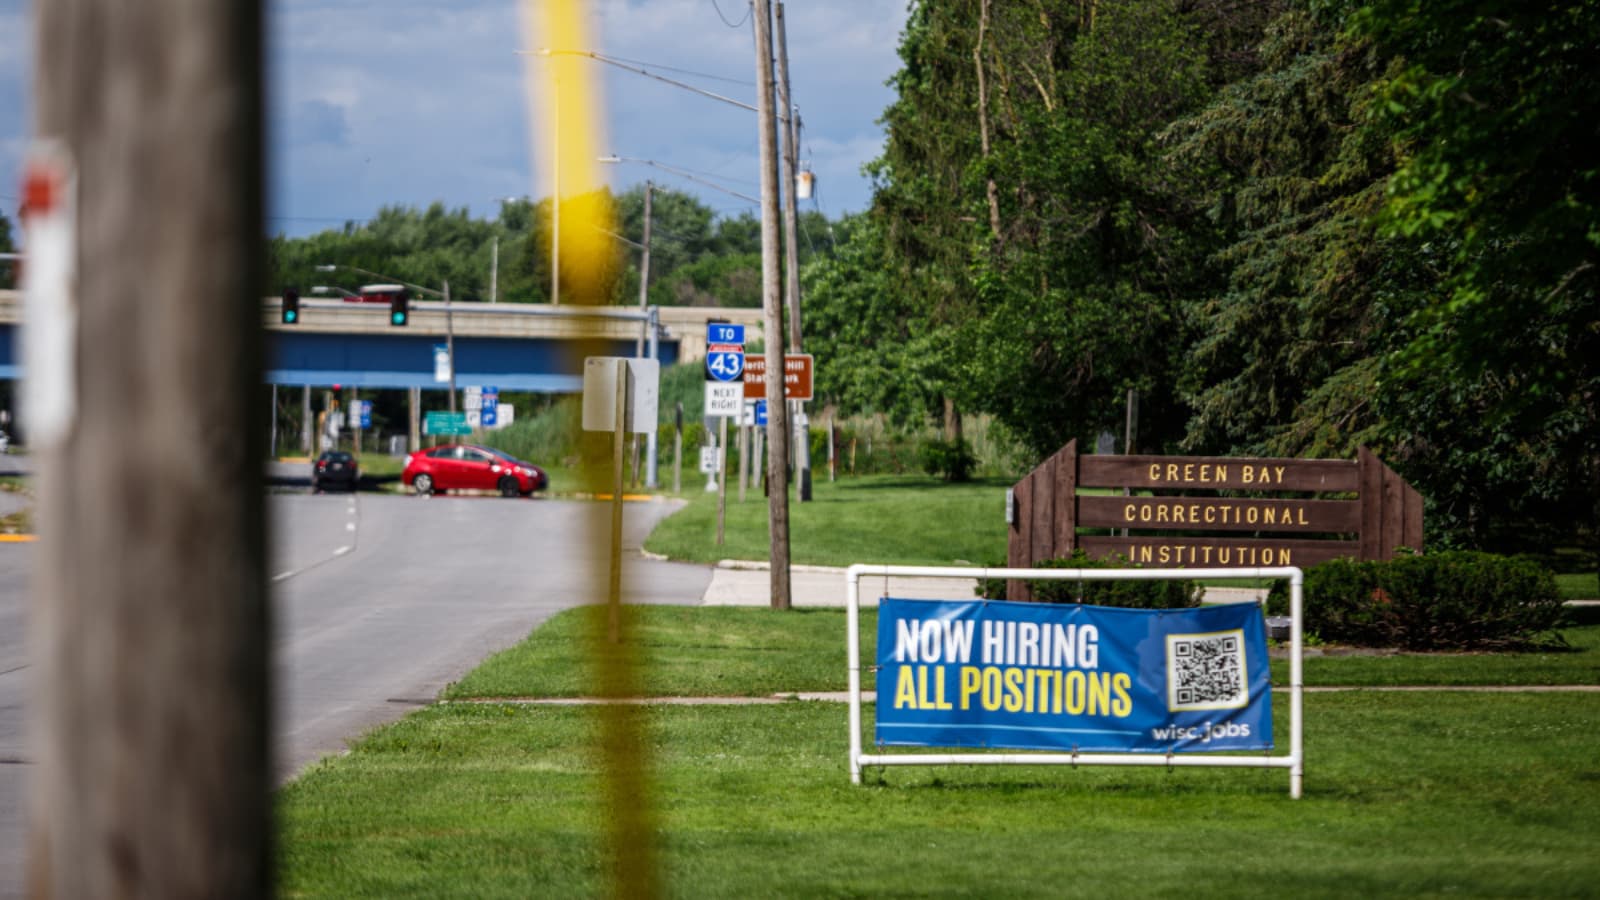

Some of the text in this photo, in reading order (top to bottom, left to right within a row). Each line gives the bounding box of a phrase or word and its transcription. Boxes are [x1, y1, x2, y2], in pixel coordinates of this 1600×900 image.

[719, 328, 735, 340] TO
[711, 354, 740, 375] 43
[786, 360, 804, 370] Hill
[745, 373, 799, 384] Stat ark
[713, 388, 735, 397] NEXT
[711, 400, 736, 409] RIGHT
[1149, 464, 1286, 484] GREEN BAY
[1124, 503, 1309, 526] CORRECTIONAL
[1129, 545, 1292, 566] INSTITUTION
[896, 618, 1099, 669] NOW HIRING
[894, 665, 1133, 718] ALL POSITIONS
[1152, 721, 1251, 743] wisc.jobs
